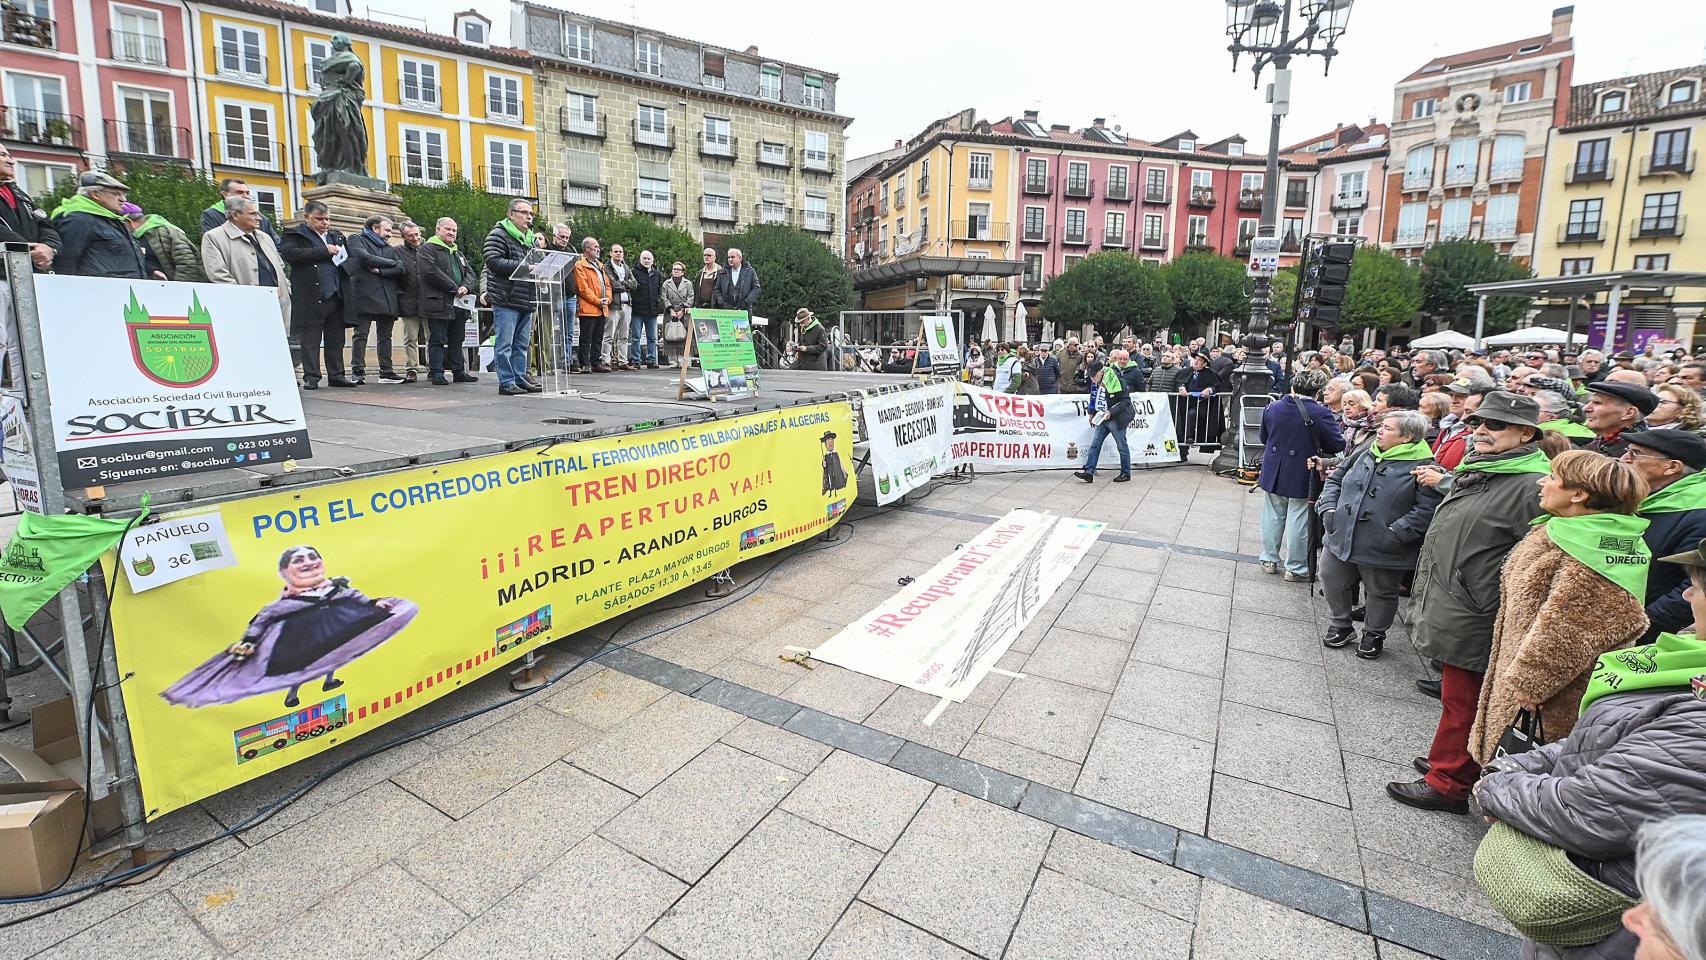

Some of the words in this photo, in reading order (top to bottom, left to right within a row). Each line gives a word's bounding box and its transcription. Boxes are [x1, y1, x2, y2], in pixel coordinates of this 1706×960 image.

[88, 395, 150, 407] Asociación
[152, 391, 201, 404] Sociedad
[203, 390, 224, 400] Civil
[226, 389, 272, 401] Burgalesa
[979, 393, 1045, 418] TREN
[877, 405, 902, 424] MADRID
[999, 416, 1046, 431] DIRECTO
[893, 414, 937, 447] NECESITAN
[100, 445, 214, 464] socibur@gmail.com
[238, 441, 256, 450] 623
[258, 439, 271, 448] 00
[272, 438, 284, 446] 56
[285, 436, 297, 444] 90
[1032, 443, 1051, 459] YA!
[99, 463, 157, 480] Síguenos
[160, 464, 179, 473] en:
[181, 456, 231, 470] @socibur
[252, 505, 320, 539] POR
[327, 498, 364, 523] EL
[370, 470, 502, 514] CORREDOR
[506, 455, 588, 485] CENTRAL
[592, 439, 680, 469] FERROVIARIO
[681, 435, 699, 451] DE
[743, 419, 778, 438] PASAJES
[780, 419, 787, 430] A
[788, 411, 830, 429] ALGECIRAS
[564, 472, 637, 507] TREN
[645, 451, 731, 490] DIRECTO
[134, 521, 210, 547] PAÑUELO
[168, 553, 191, 569] 3€
[497, 558, 595, 607] MADRID
[616, 525, 698, 564] ARANDA
[712, 498, 769, 531] BURGOS
[1605, 555, 1648, 565] DIRECTO
[575, 581, 623, 605] PLANTE
[628, 567, 661, 587] PLAZA
[663, 553, 695, 572] MAYOR
[696, 539, 730, 558] BURGOS
[603, 583, 656, 610] SÁBADOS
[658, 571, 680, 589] 13,30
[682, 569, 689, 579] A
